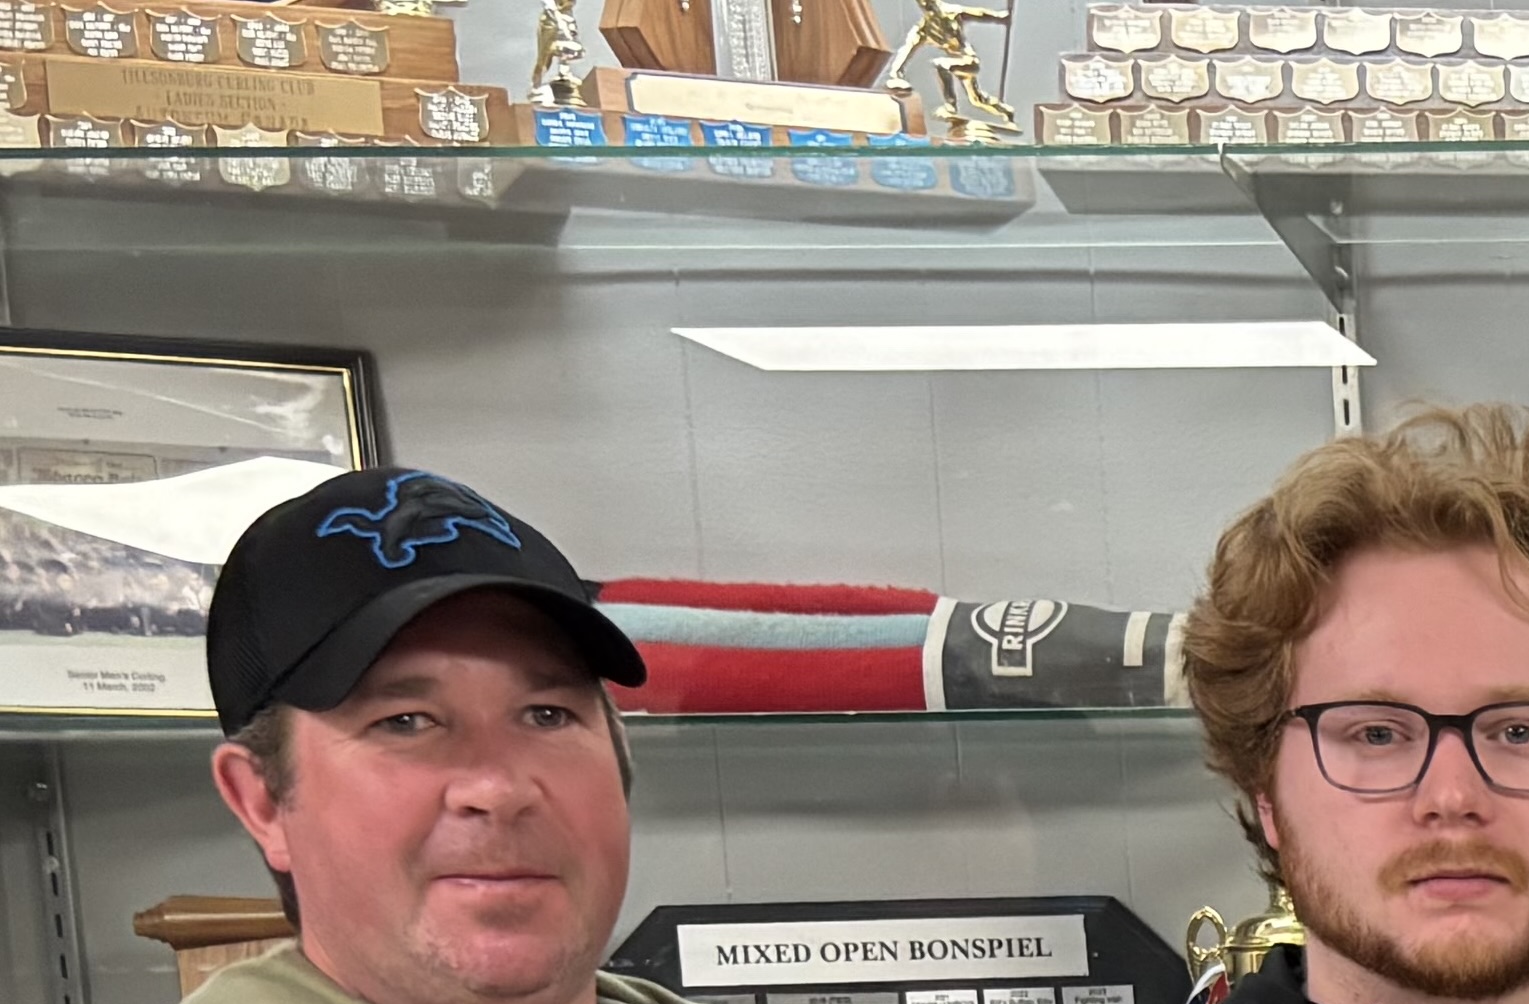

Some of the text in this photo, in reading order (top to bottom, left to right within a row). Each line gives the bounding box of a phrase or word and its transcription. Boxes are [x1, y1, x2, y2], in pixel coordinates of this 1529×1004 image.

[122, 68, 315, 95] TILLSONBURG CURLING CLUB
[716, 937, 1053, 966] MIXED OPEN BONSPIEL
